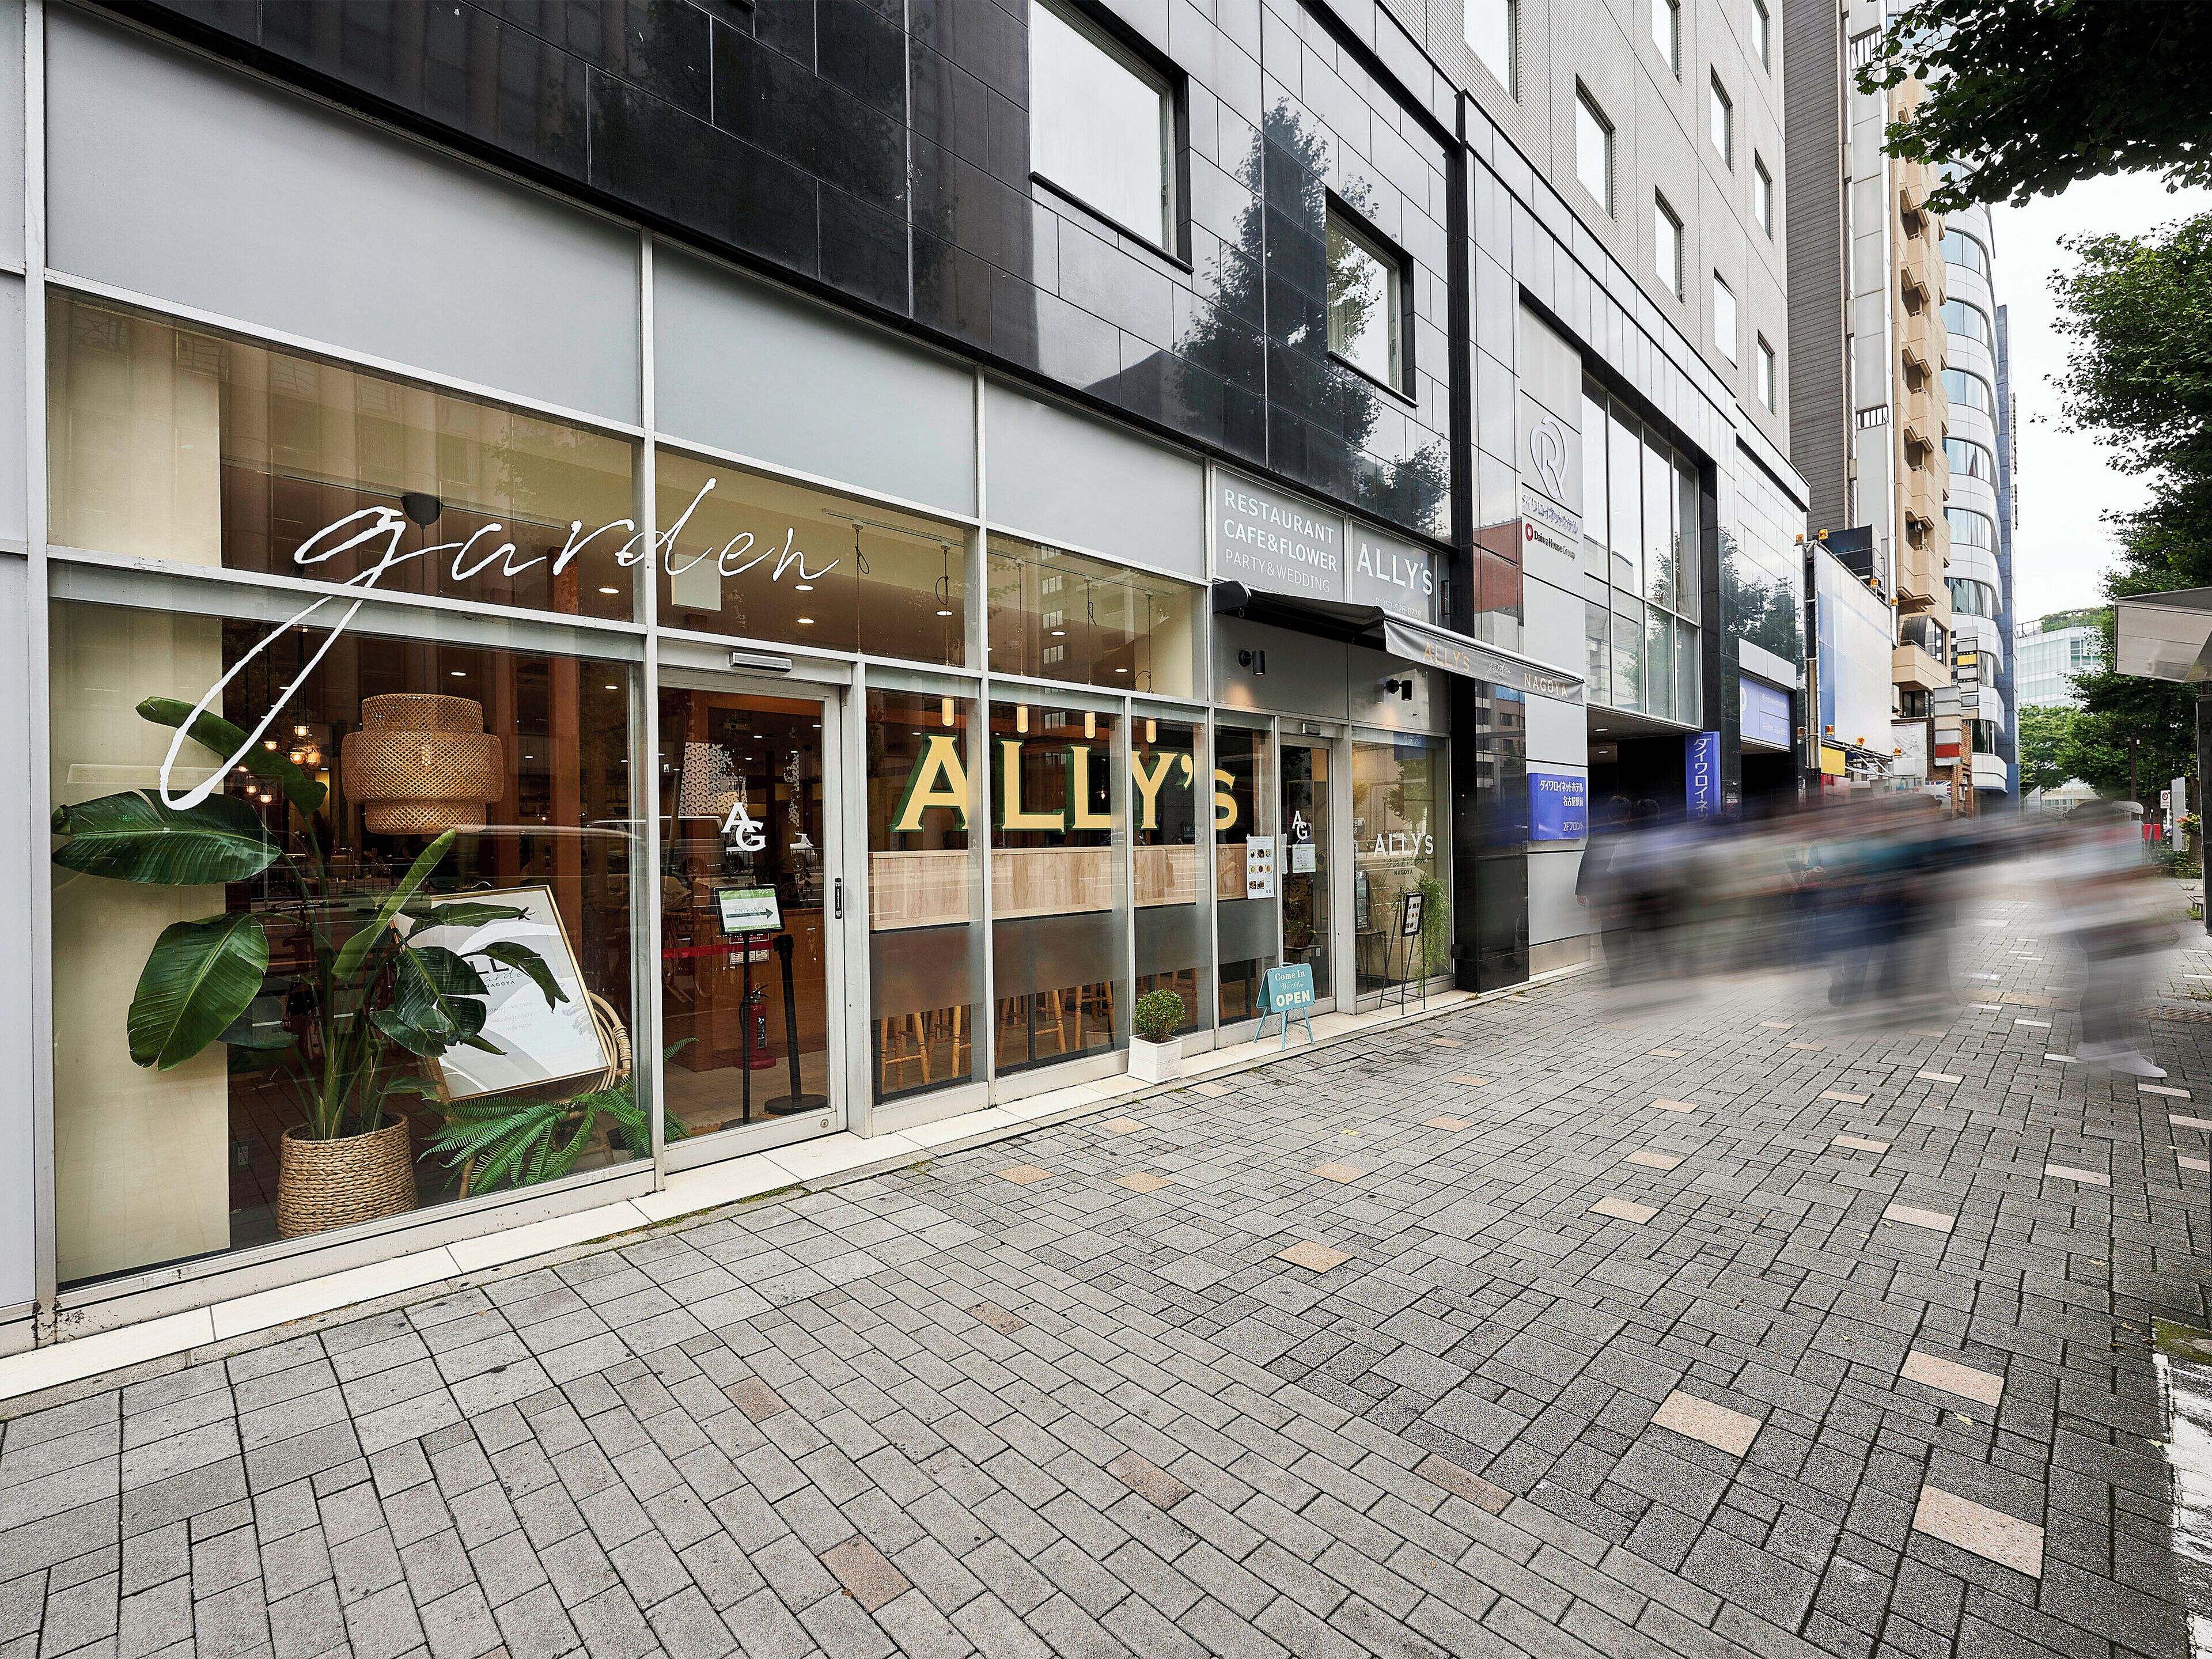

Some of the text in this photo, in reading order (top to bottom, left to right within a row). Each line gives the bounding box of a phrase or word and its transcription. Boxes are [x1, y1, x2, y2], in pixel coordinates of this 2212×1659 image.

[1225, 488, 1334, 544] RESTAURANT
[1224, 518, 1338, 572] CAFE&FLOWER
[1534, 530, 1548, 547] Daiwa
[1548, 537, 1563, 553] House
[1226, 548, 1331, 593] PARTY&WEDDING
[159, 476, 841, 811] garden
[1484, 660, 1513, 681] garden
[1524, 672, 1569, 698] NAGOYA
[1540, 780, 1584, 793] ダイワロイネットホテル
[1275, 969, 1305, 981] Come In
[1280, 981, 1290, 991] We
[1276, 990, 1310, 1007] OPEN
